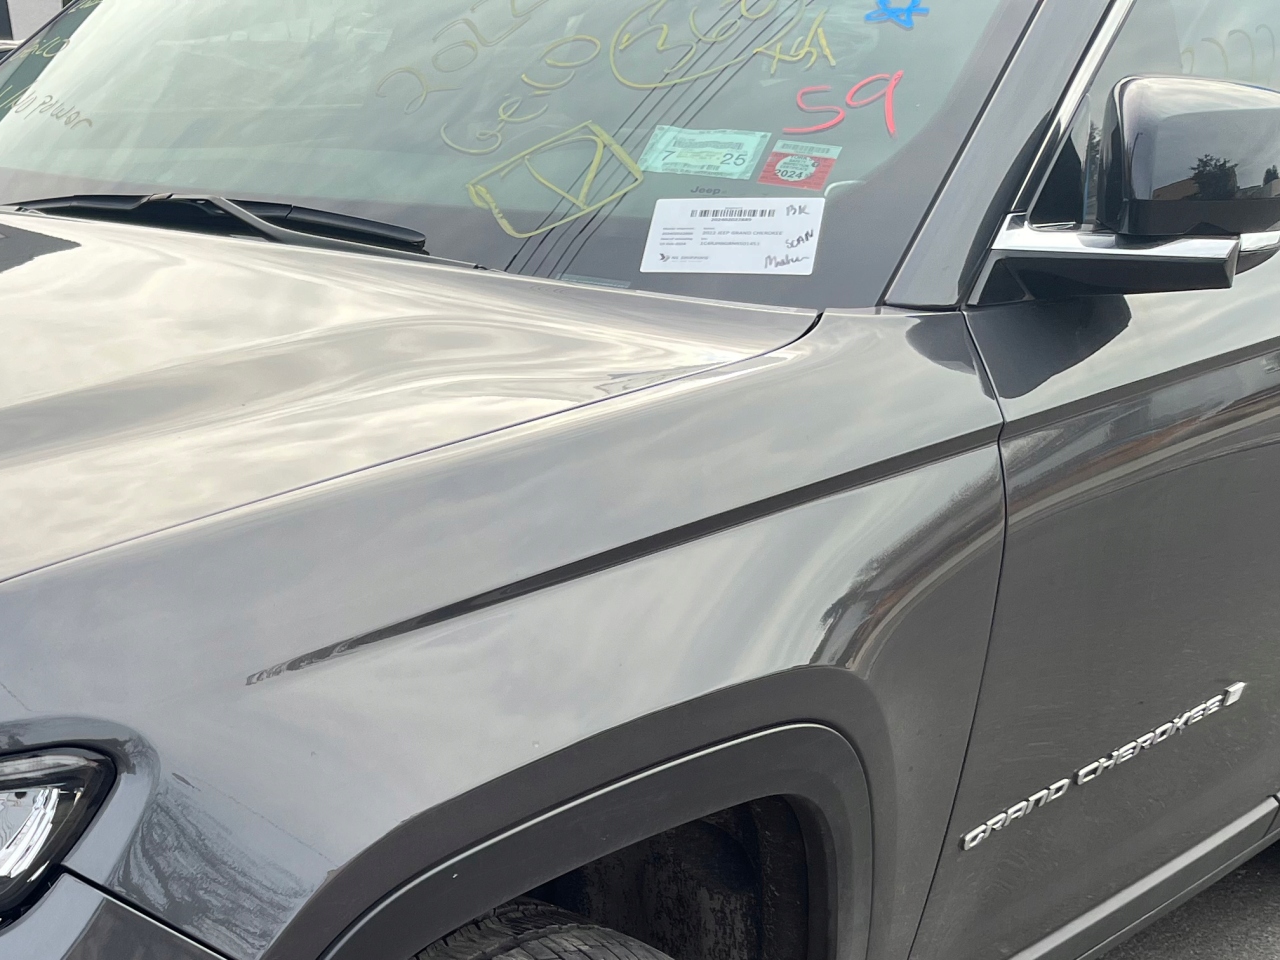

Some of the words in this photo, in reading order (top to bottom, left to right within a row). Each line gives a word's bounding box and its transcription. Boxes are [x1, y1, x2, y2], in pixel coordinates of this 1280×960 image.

[661, 150, 677, 162] 7
[720, 152, 748, 167] 25
[775, 169, 804, 179] 2024
[690, 185, 721, 195] Jeep
[959, 777, 1072, 852] GRAND
[1073, 692, 1226, 787] CHEROKEE
